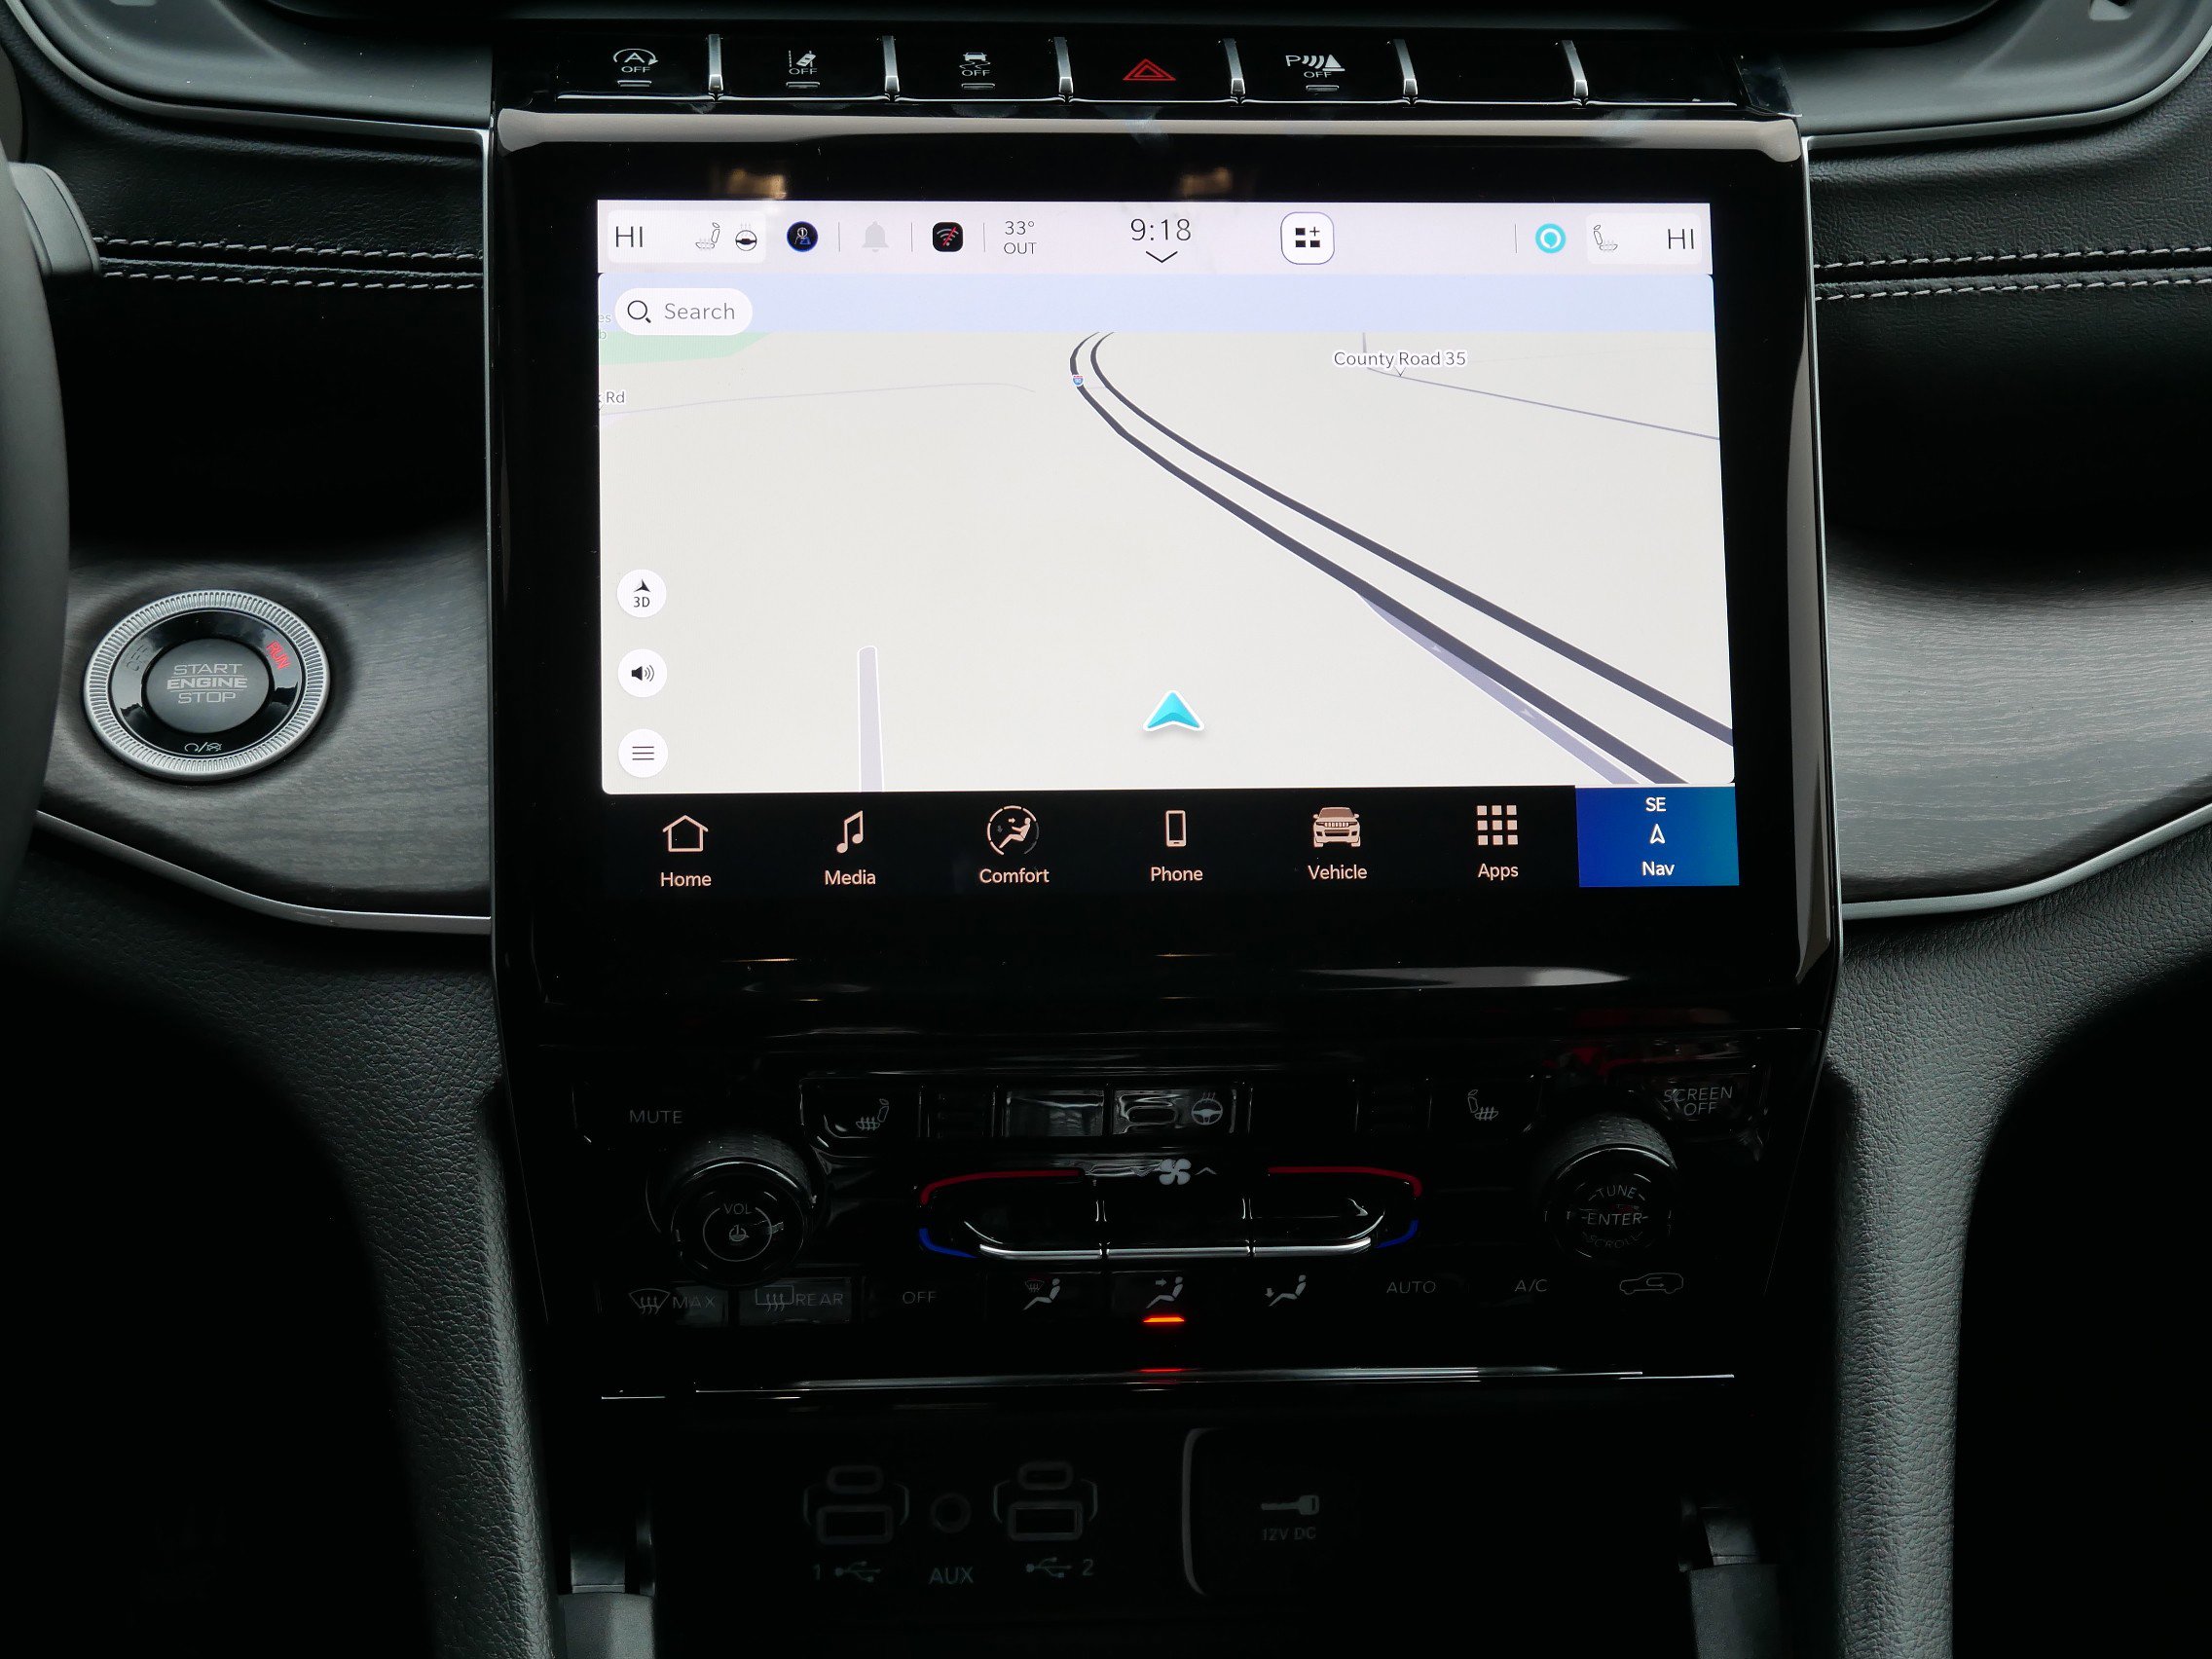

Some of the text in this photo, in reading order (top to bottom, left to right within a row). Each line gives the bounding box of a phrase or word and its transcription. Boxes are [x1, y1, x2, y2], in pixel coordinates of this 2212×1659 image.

[620, 65, 651, 74] OFF
[788, 67, 818, 76] OFF
[961, 69, 991, 78] OFF
[1004, 220, 1036, 236] 33°
[1129, 218, 1193, 242] 9:18
[615, 225, 644, 248] HI
[1667, 228, 1696, 250] HI
[1003, 241, 1038, 256] OUT
[664, 302, 736, 320] Search
[1333, 351, 1467, 369] County Road 35
[606, 391, 625, 403] Rd
[633, 596, 650, 608] 3D
[266, 640, 291, 670] RUN
[173, 663, 243, 676] START
[166, 677, 248, 690] ENGINE
[177, 691, 237, 704] STOP
[1645, 797, 1667, 812] SE
[978, 868, 1050, 885] Comfort
[1150, 866, 1203, 882] Phone
[1308, 865, 1368, 880] Vehicle
[1478, 863, 1519, 880] Apps
[1641, 862, 1676, 877] Nav
[660, 871, 712, 887] Home
[824, 869, 877, 886] Media
[1664, 1086, 1733, 1103] SCREEN
[1683, 1101, 1717, 1116] OFF
[628, 1109, 683, 1124] MUTE
[1596, 1184, 1638, 1198] TUNE
[723, 1202, 753, 1215] VOL
[1587, 1212, 1642, 1226] ENTER
[1386, 1281, 1437, 1295] AUTO
[1514, 1279, 1549, 1293] A/C
[672, 1295, 717, 1309] MAX
[795, 1293, 844, 1306] REAR
[902, 1291, 938, 1306] OFF
[1262, 1526, 1317, 1541] 12V DC
[813, 1563, 822, 1581] 1
[1081, 1560, 1095, 1577] 2
[928, 1567, 974, 1586] AUX
